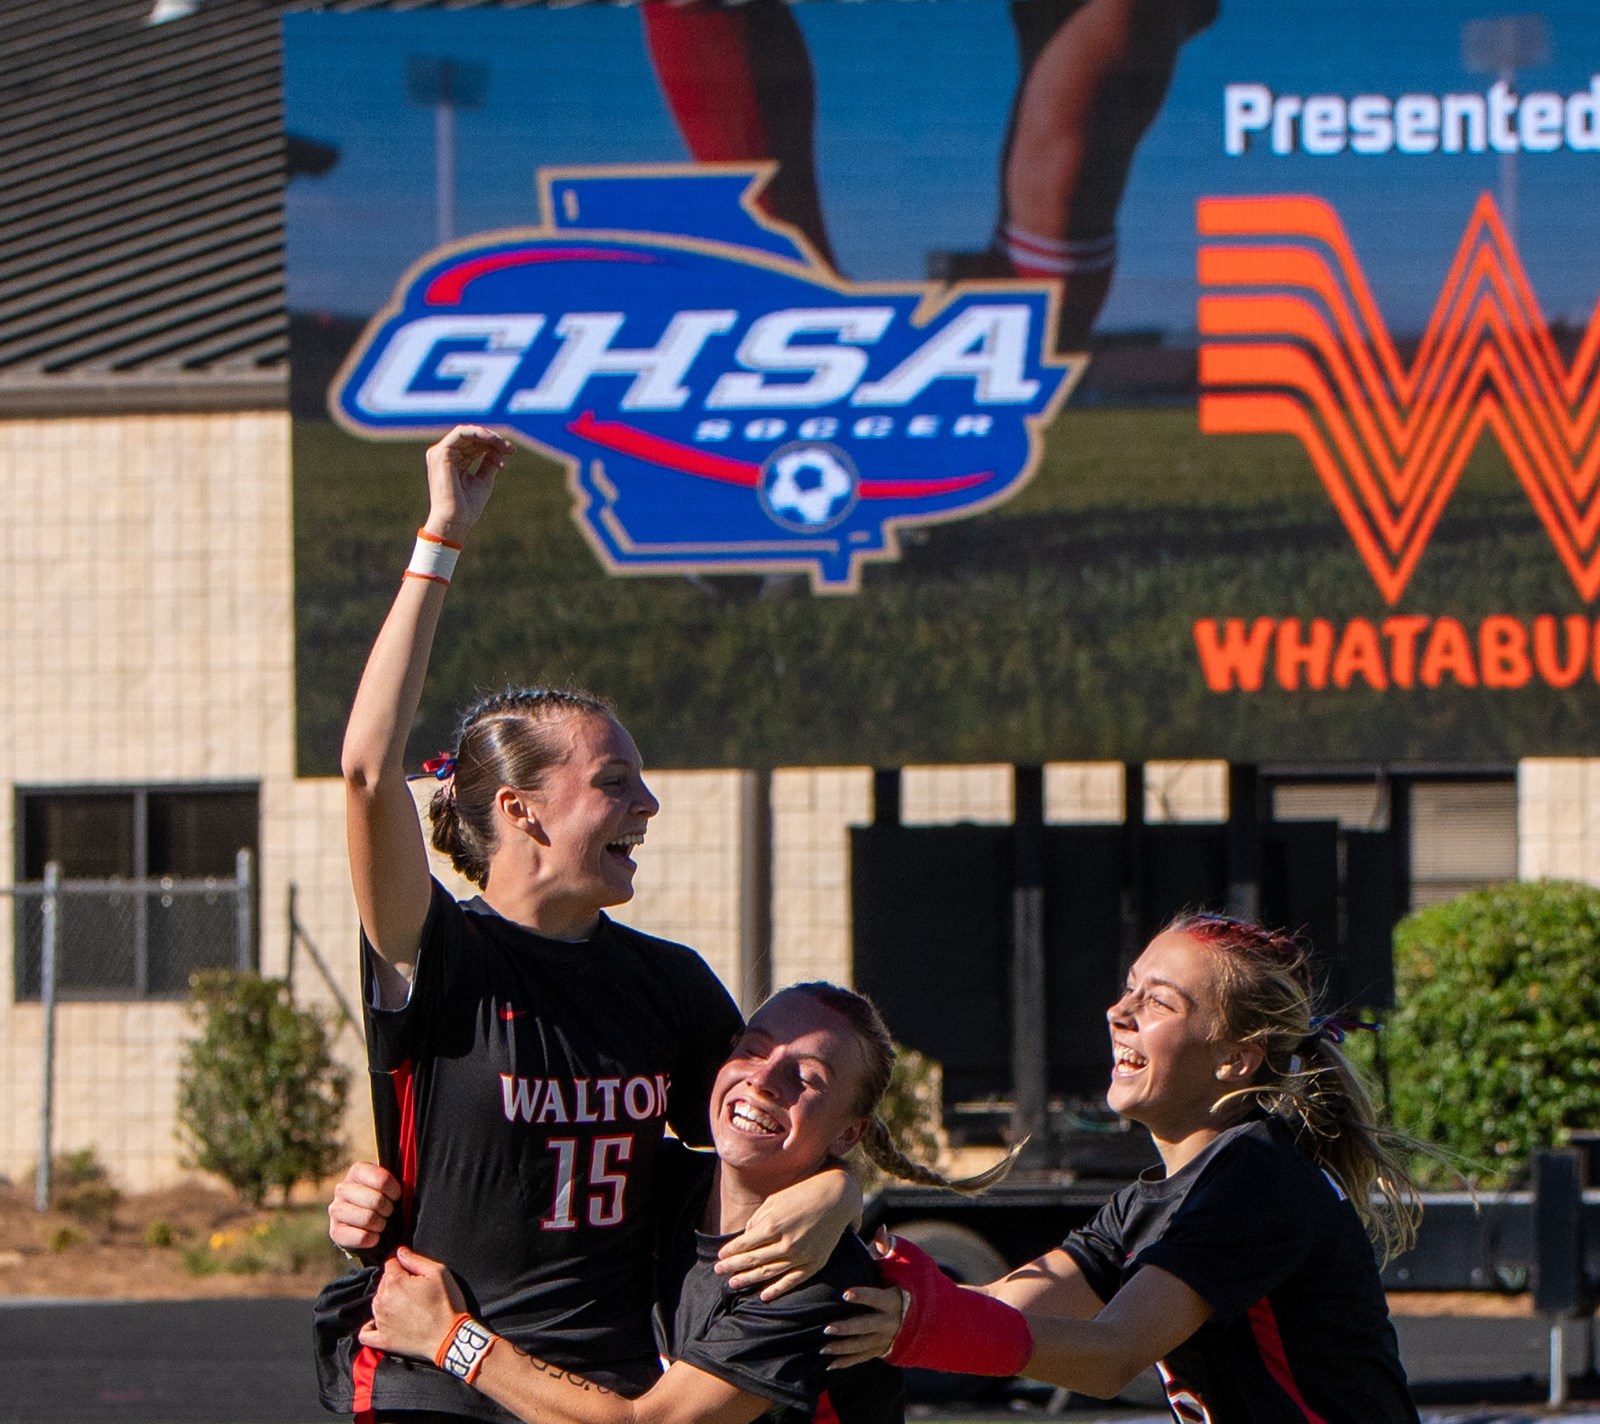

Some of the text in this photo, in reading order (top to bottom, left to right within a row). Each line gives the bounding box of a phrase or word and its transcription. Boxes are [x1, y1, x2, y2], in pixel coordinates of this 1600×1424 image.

[1224, 74, 1600, 155] Presented
[355, 304, 1042, 415] GHSA
[693, 413, 994, 442] SOCCER
[1194, 613, 1600, 692] WHATABU
[541, 1133, 635, 1231] 15
